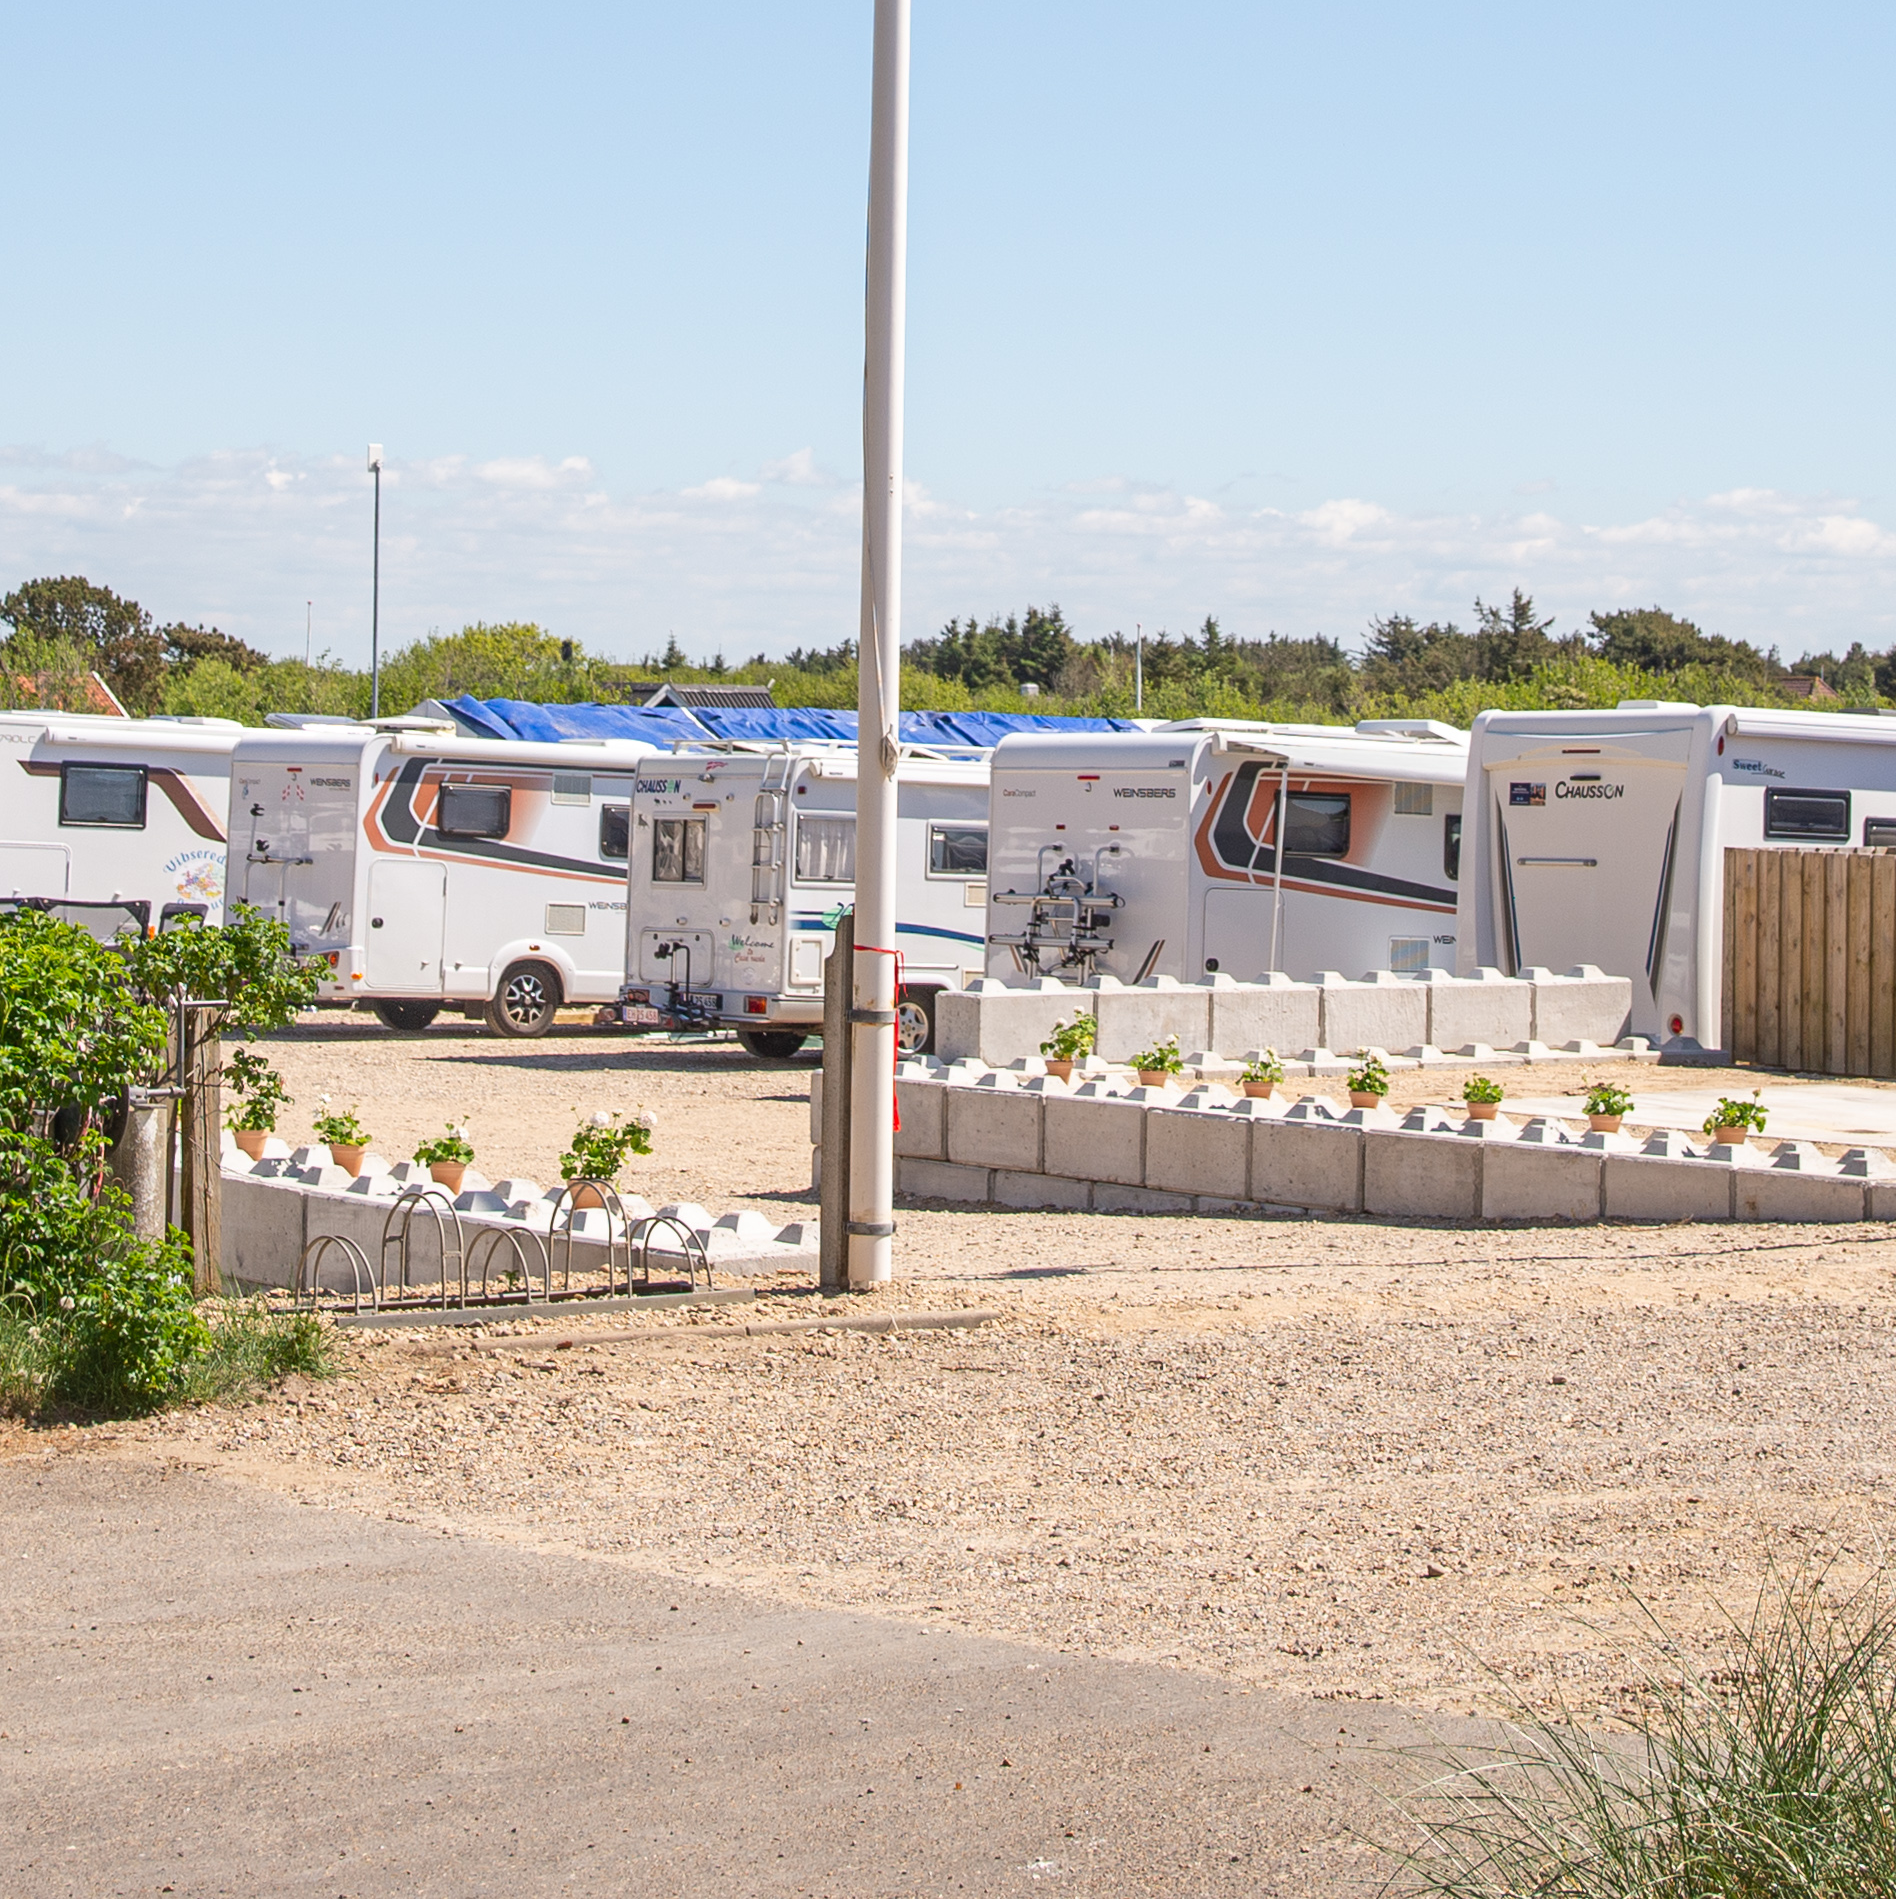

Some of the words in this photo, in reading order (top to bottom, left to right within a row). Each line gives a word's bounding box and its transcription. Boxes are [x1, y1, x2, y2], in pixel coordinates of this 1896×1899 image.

[1733, 760, 1762, 772] Sweet
[636, 780, 681, 794] CHAUSSON
[731, 934, 775, 949] Welcome
